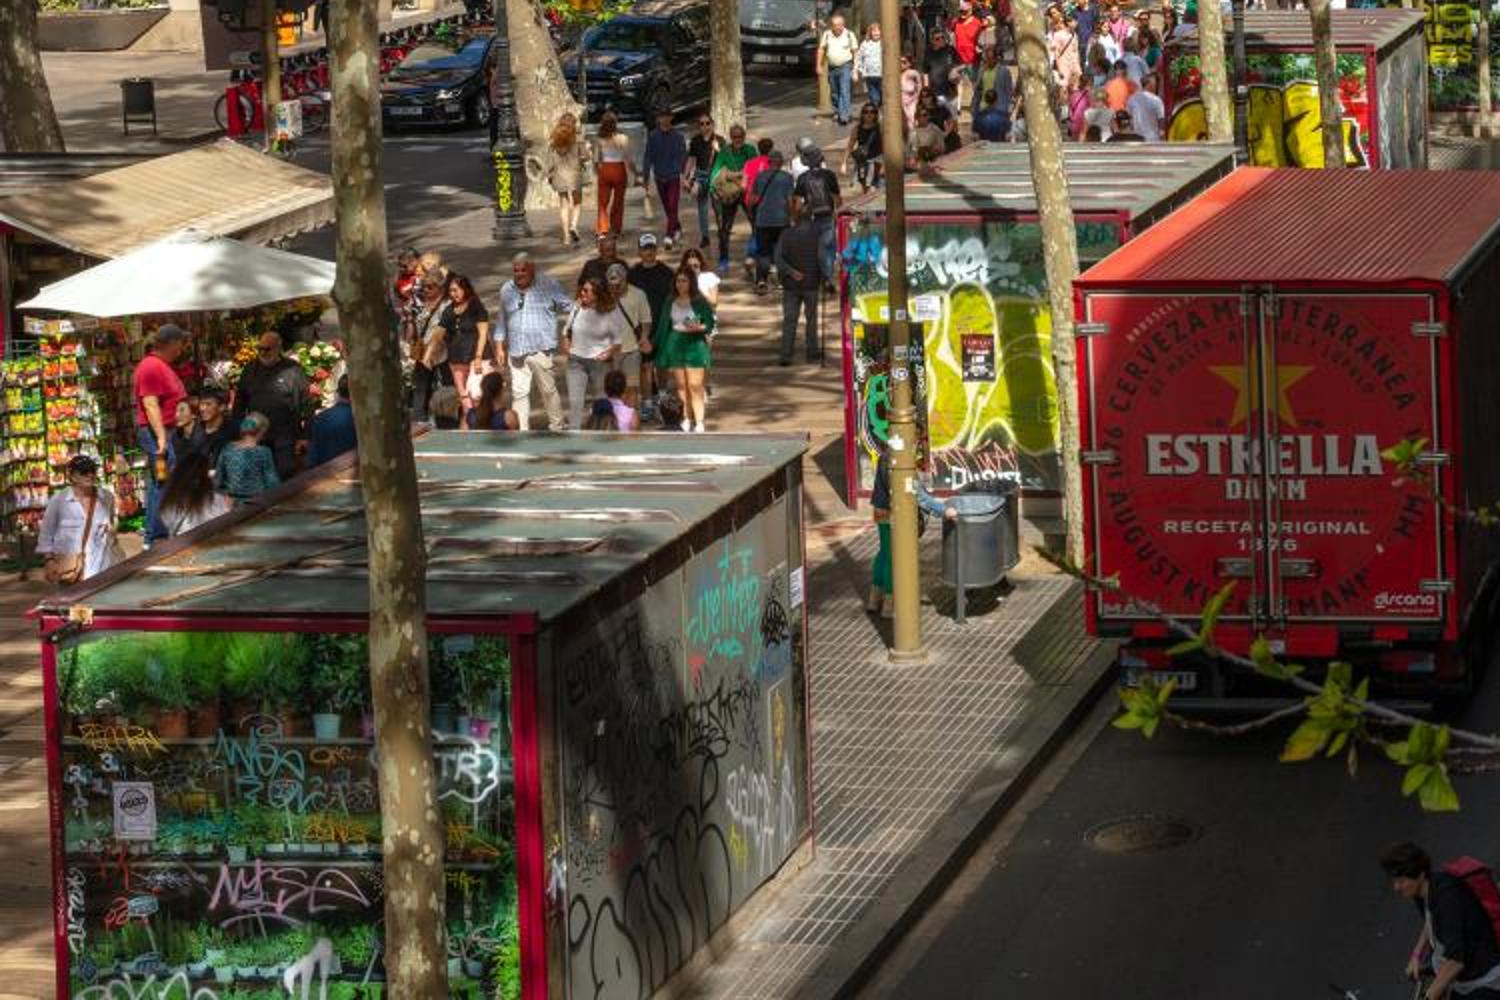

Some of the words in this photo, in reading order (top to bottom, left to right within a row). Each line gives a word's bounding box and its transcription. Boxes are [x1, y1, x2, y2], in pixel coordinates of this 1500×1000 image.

[1108, 311, 1207, 413] CERVEZA
[1145, 433, 1385, 476] ESTRELLA
[1225, 478, 1307, 501] DAMM
[1105, 490, 1183, 586] AUGUST
[1163, 519, 1253, 534] RECETA
[1259, 519, 1372, 535] ORIGINAL
